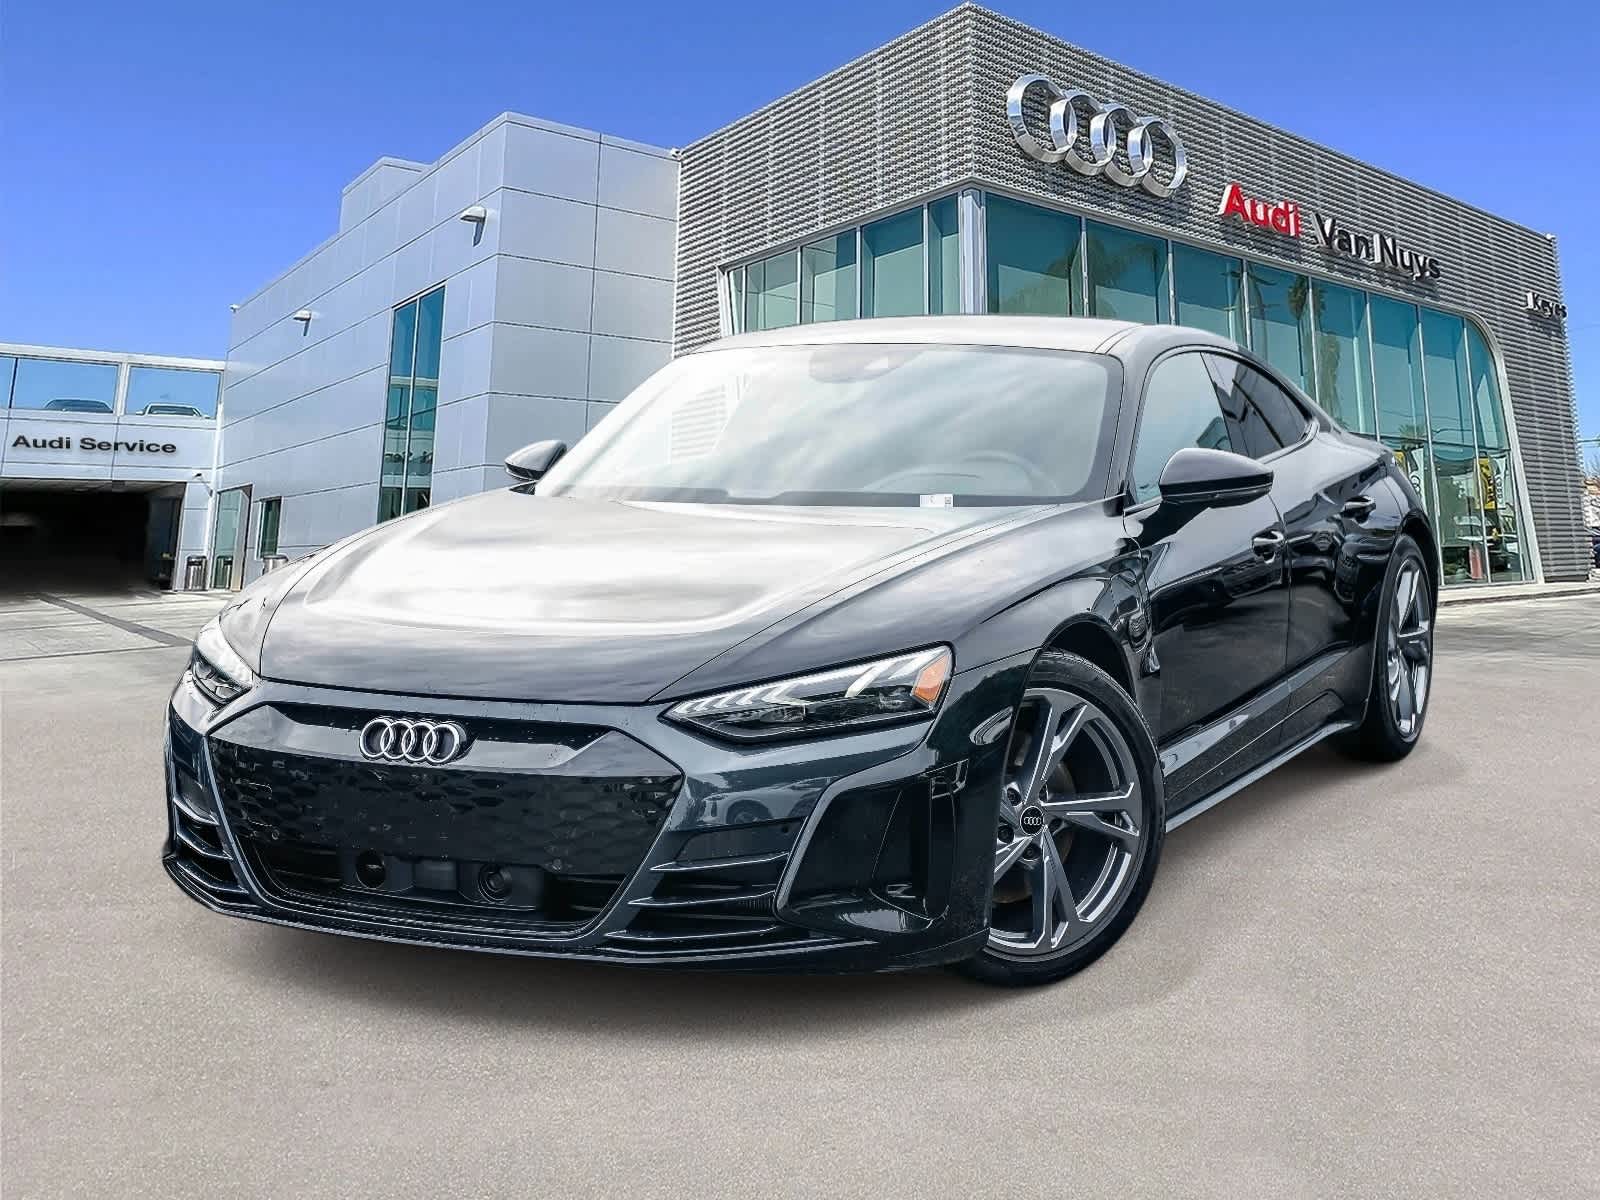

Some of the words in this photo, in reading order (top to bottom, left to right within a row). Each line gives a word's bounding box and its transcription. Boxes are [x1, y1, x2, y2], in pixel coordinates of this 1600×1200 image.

[1217, 182, 1302, 238] Audi
[1311, 212, 1372, 258] Van
[1373, 233, 1442, 280] Nuys
[12, 435, 71, 449] Audi
[79, 437, 177, 454] Service
